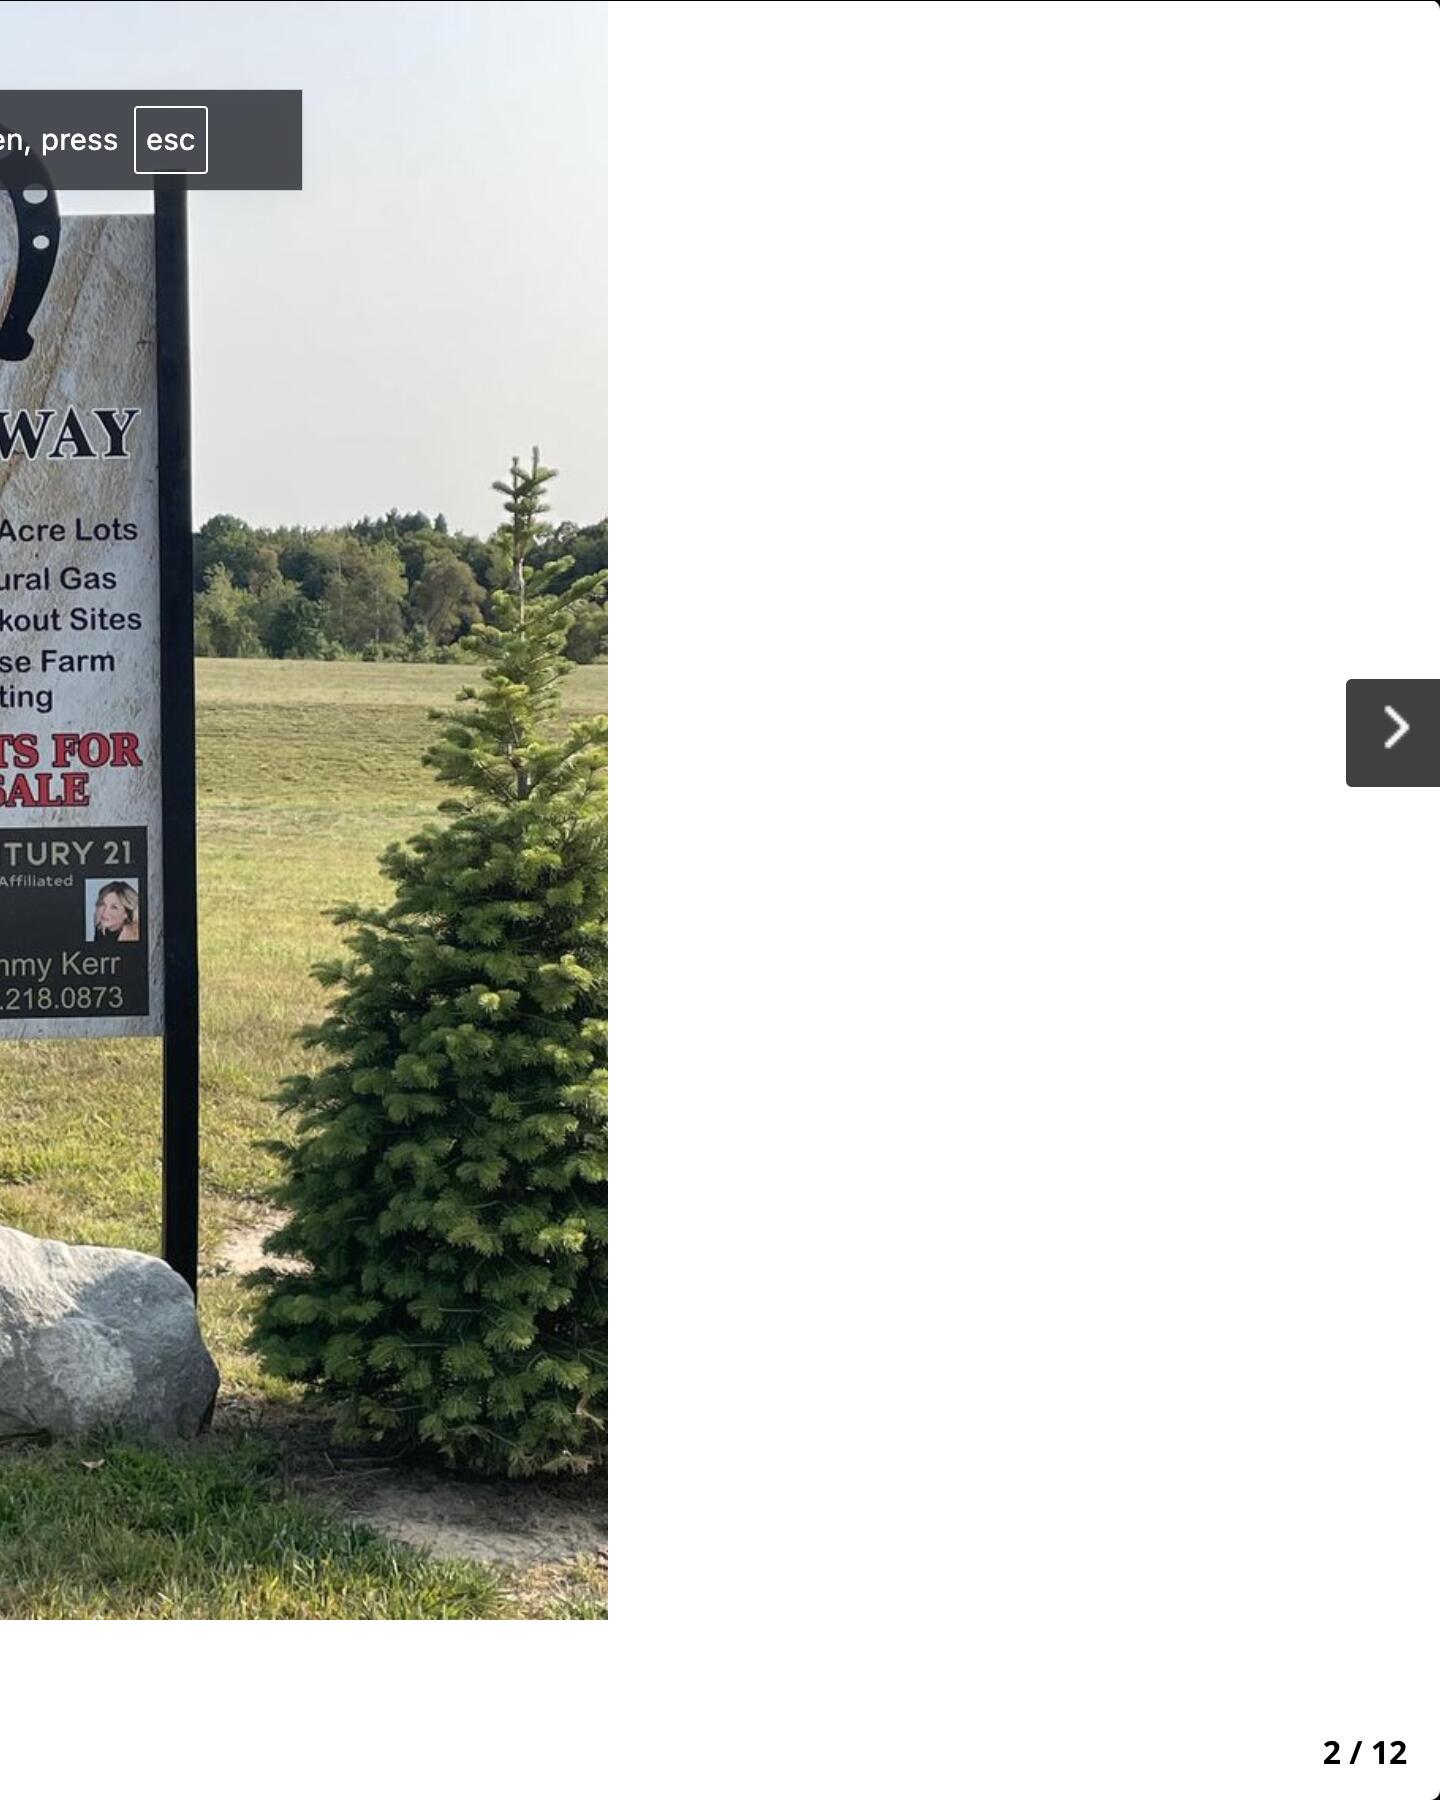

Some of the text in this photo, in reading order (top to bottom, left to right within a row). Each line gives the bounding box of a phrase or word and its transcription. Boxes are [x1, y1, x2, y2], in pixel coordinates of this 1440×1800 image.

[75, 517, 139, 541] Lots
[60, 566, 118, 590] Gas
[70, 607, 143, 631] Sites
[41, 649, 116, 673] Farm
[51, 732, 143, 768] FOR
[103, 840, 132, 865] 21
[61, 951, 122, 976] Kerr
